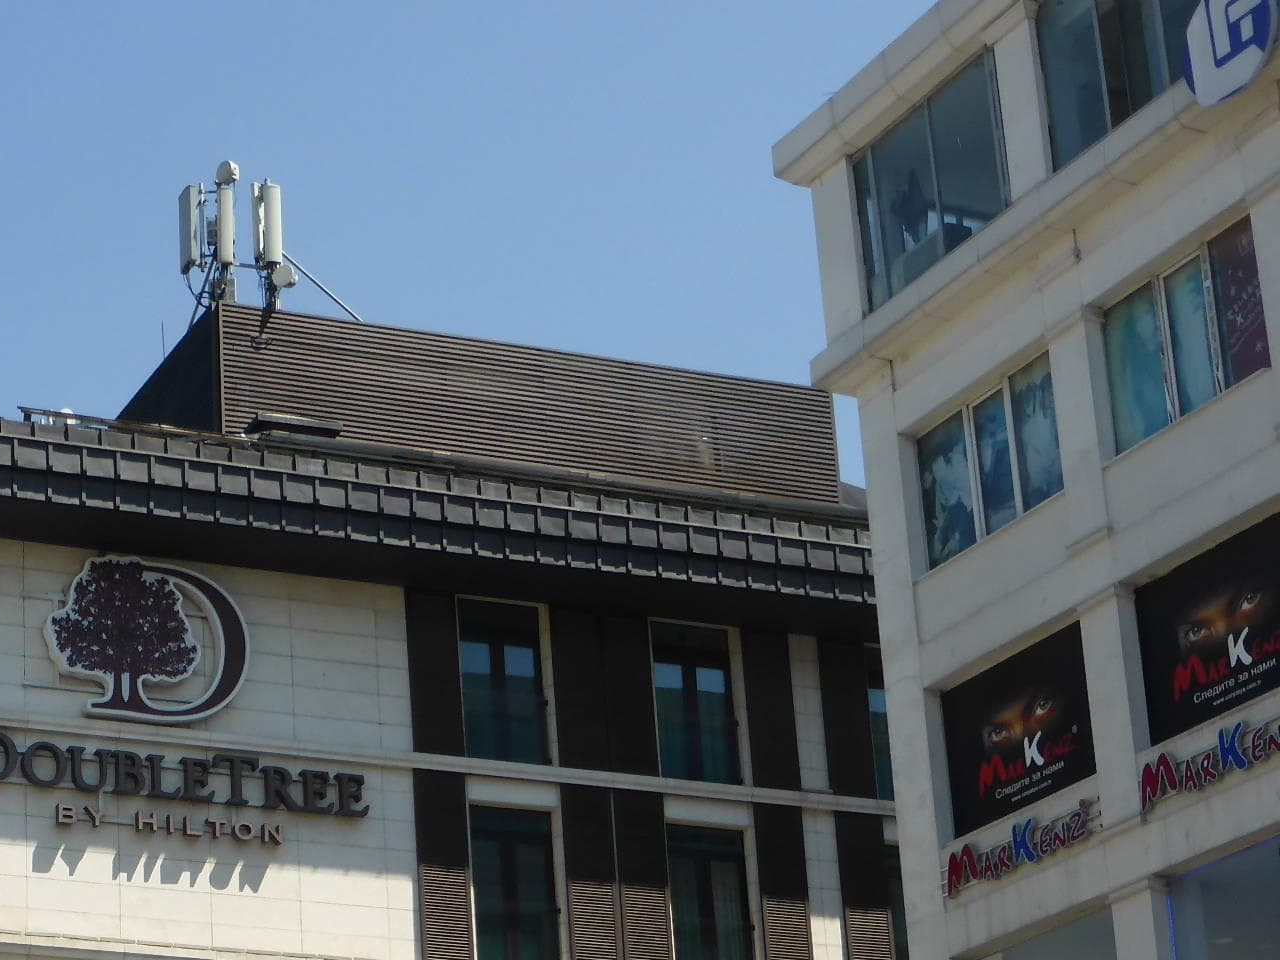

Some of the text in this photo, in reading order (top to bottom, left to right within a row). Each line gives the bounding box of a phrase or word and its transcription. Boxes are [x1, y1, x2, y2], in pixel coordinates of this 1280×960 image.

[1194, 678, 1235, 704] Следите
[1237, 669, 1248, 683] за
[1251, 657, 1277, 676] нами
[995, 778, 1030, 799] Следите
[1031, 772, 1041, 783] за
[1042, 760, 1066, 777] нами
[55, 802, 284, 846] BY HILTON
